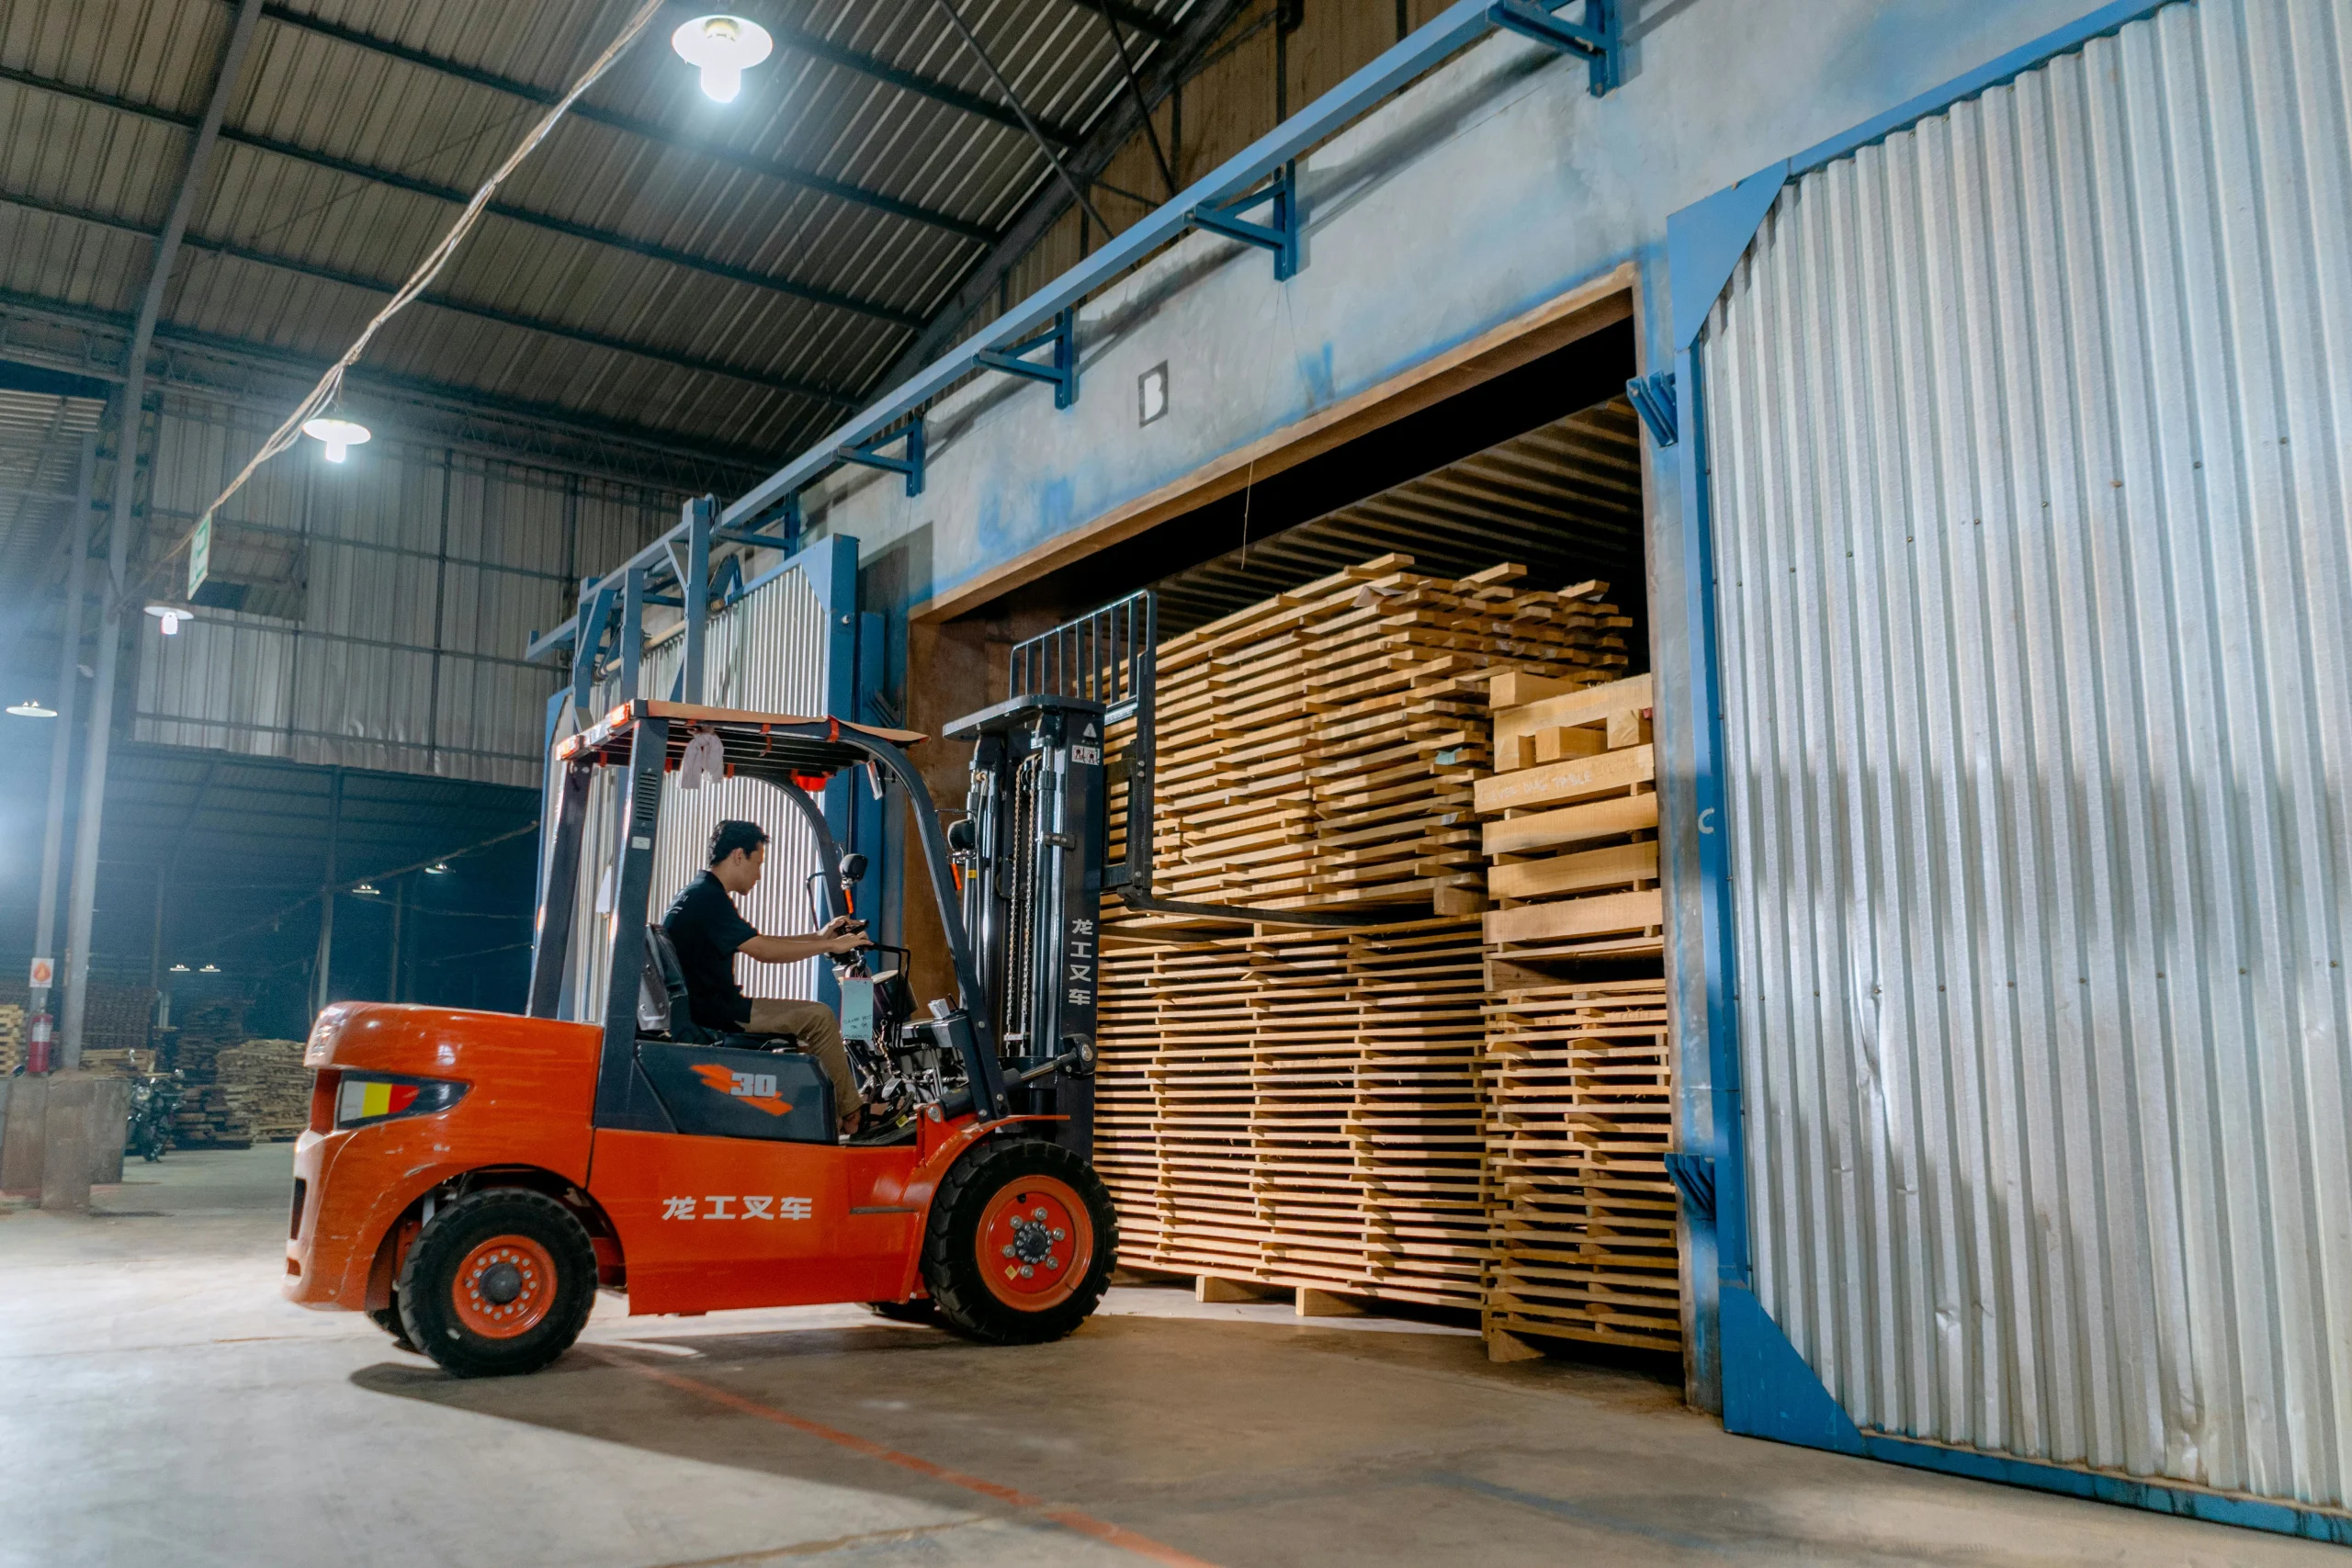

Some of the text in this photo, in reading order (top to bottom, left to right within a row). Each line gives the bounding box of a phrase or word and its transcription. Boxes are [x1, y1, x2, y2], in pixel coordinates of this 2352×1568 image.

[730, 1072, 777, 1097] 30
[662, 1195, 813, 1221] 龙工叉车
